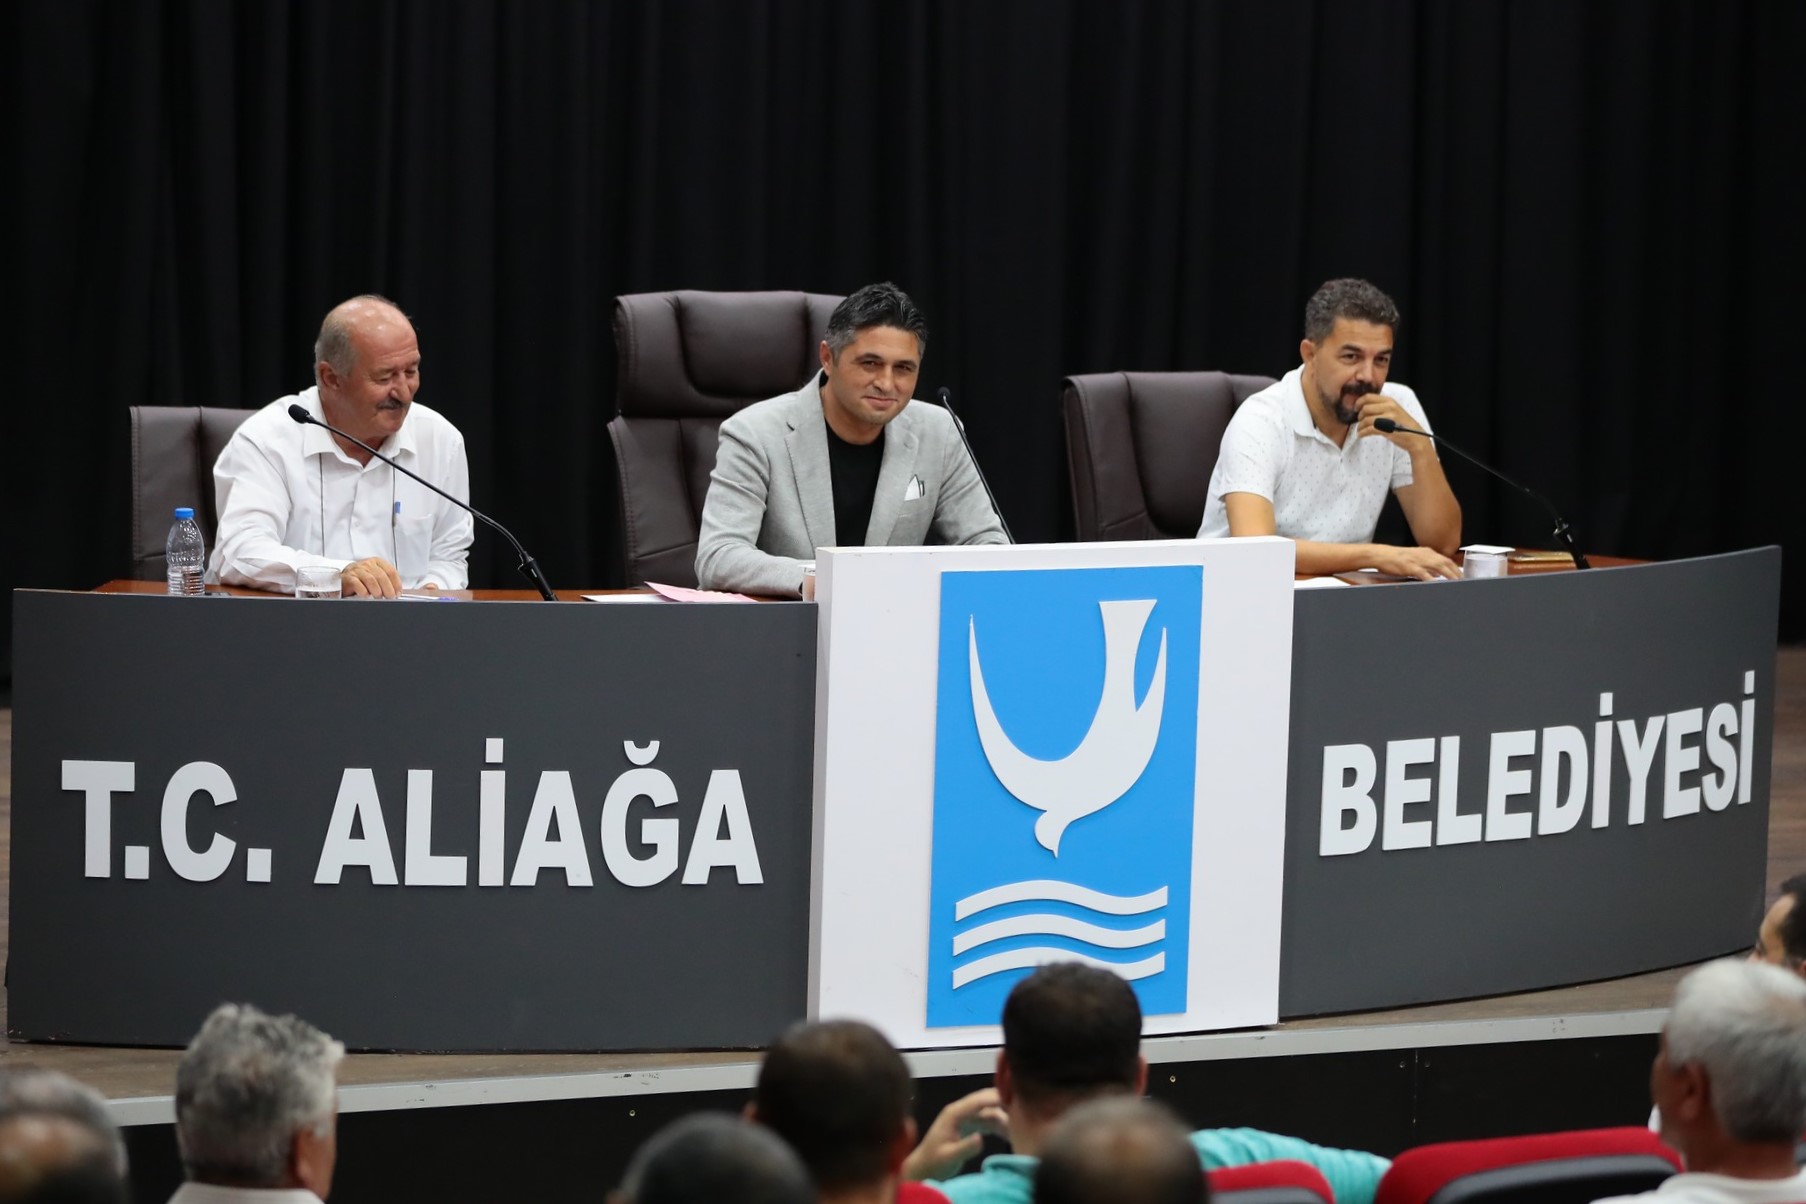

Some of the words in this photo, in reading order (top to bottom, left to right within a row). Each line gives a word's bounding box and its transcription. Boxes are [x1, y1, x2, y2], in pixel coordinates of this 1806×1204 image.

[61, 759, 273, 884] T.C.
[313, 737, 765, 888] ALİAĞA
[1318, 669, 1757, 858] BELEDİYESİ
